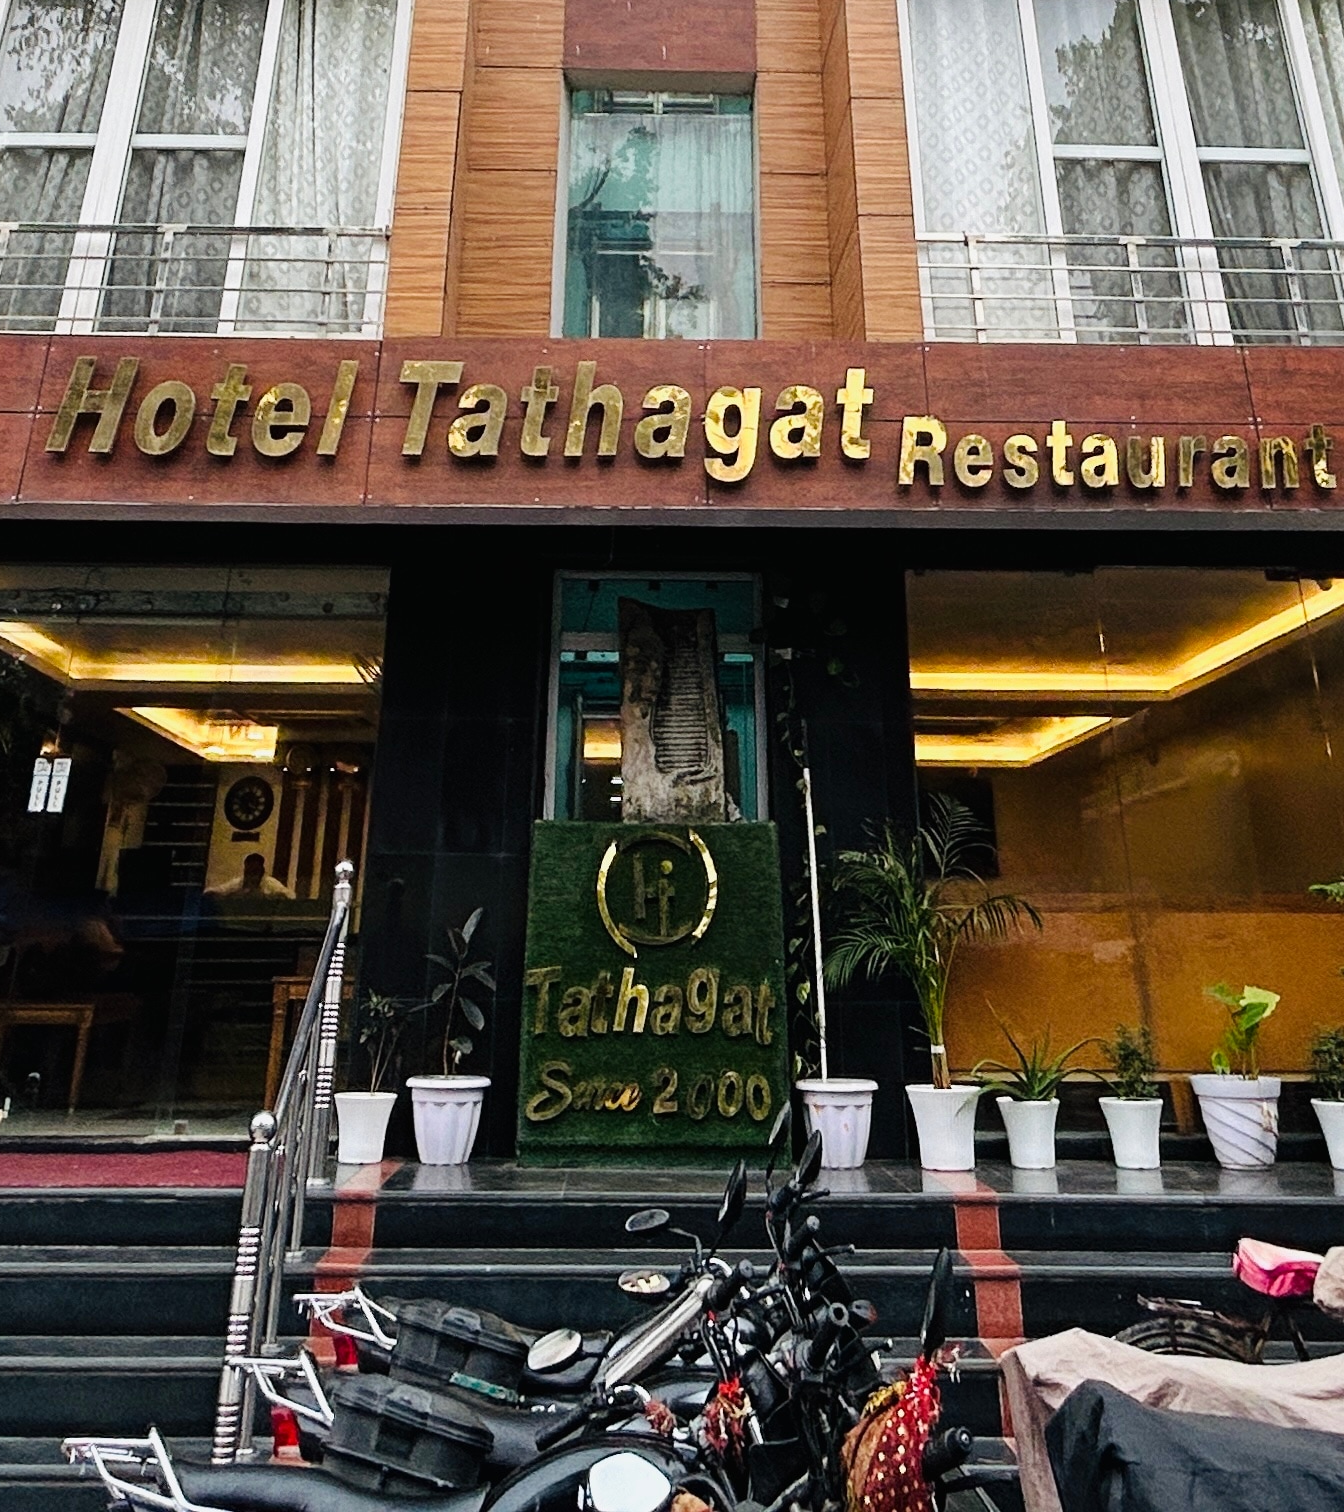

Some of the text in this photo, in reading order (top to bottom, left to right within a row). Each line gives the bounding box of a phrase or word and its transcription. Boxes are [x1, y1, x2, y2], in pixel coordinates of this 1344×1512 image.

[45, 355, 360, 458] Hotel
[399, 359, 874, 483] Tathagat
[897, 415, 1337, 489] Restaurant
[524, 964, 777, 1046] Tathagat
[652, 1065, 773, 1122] 2000
